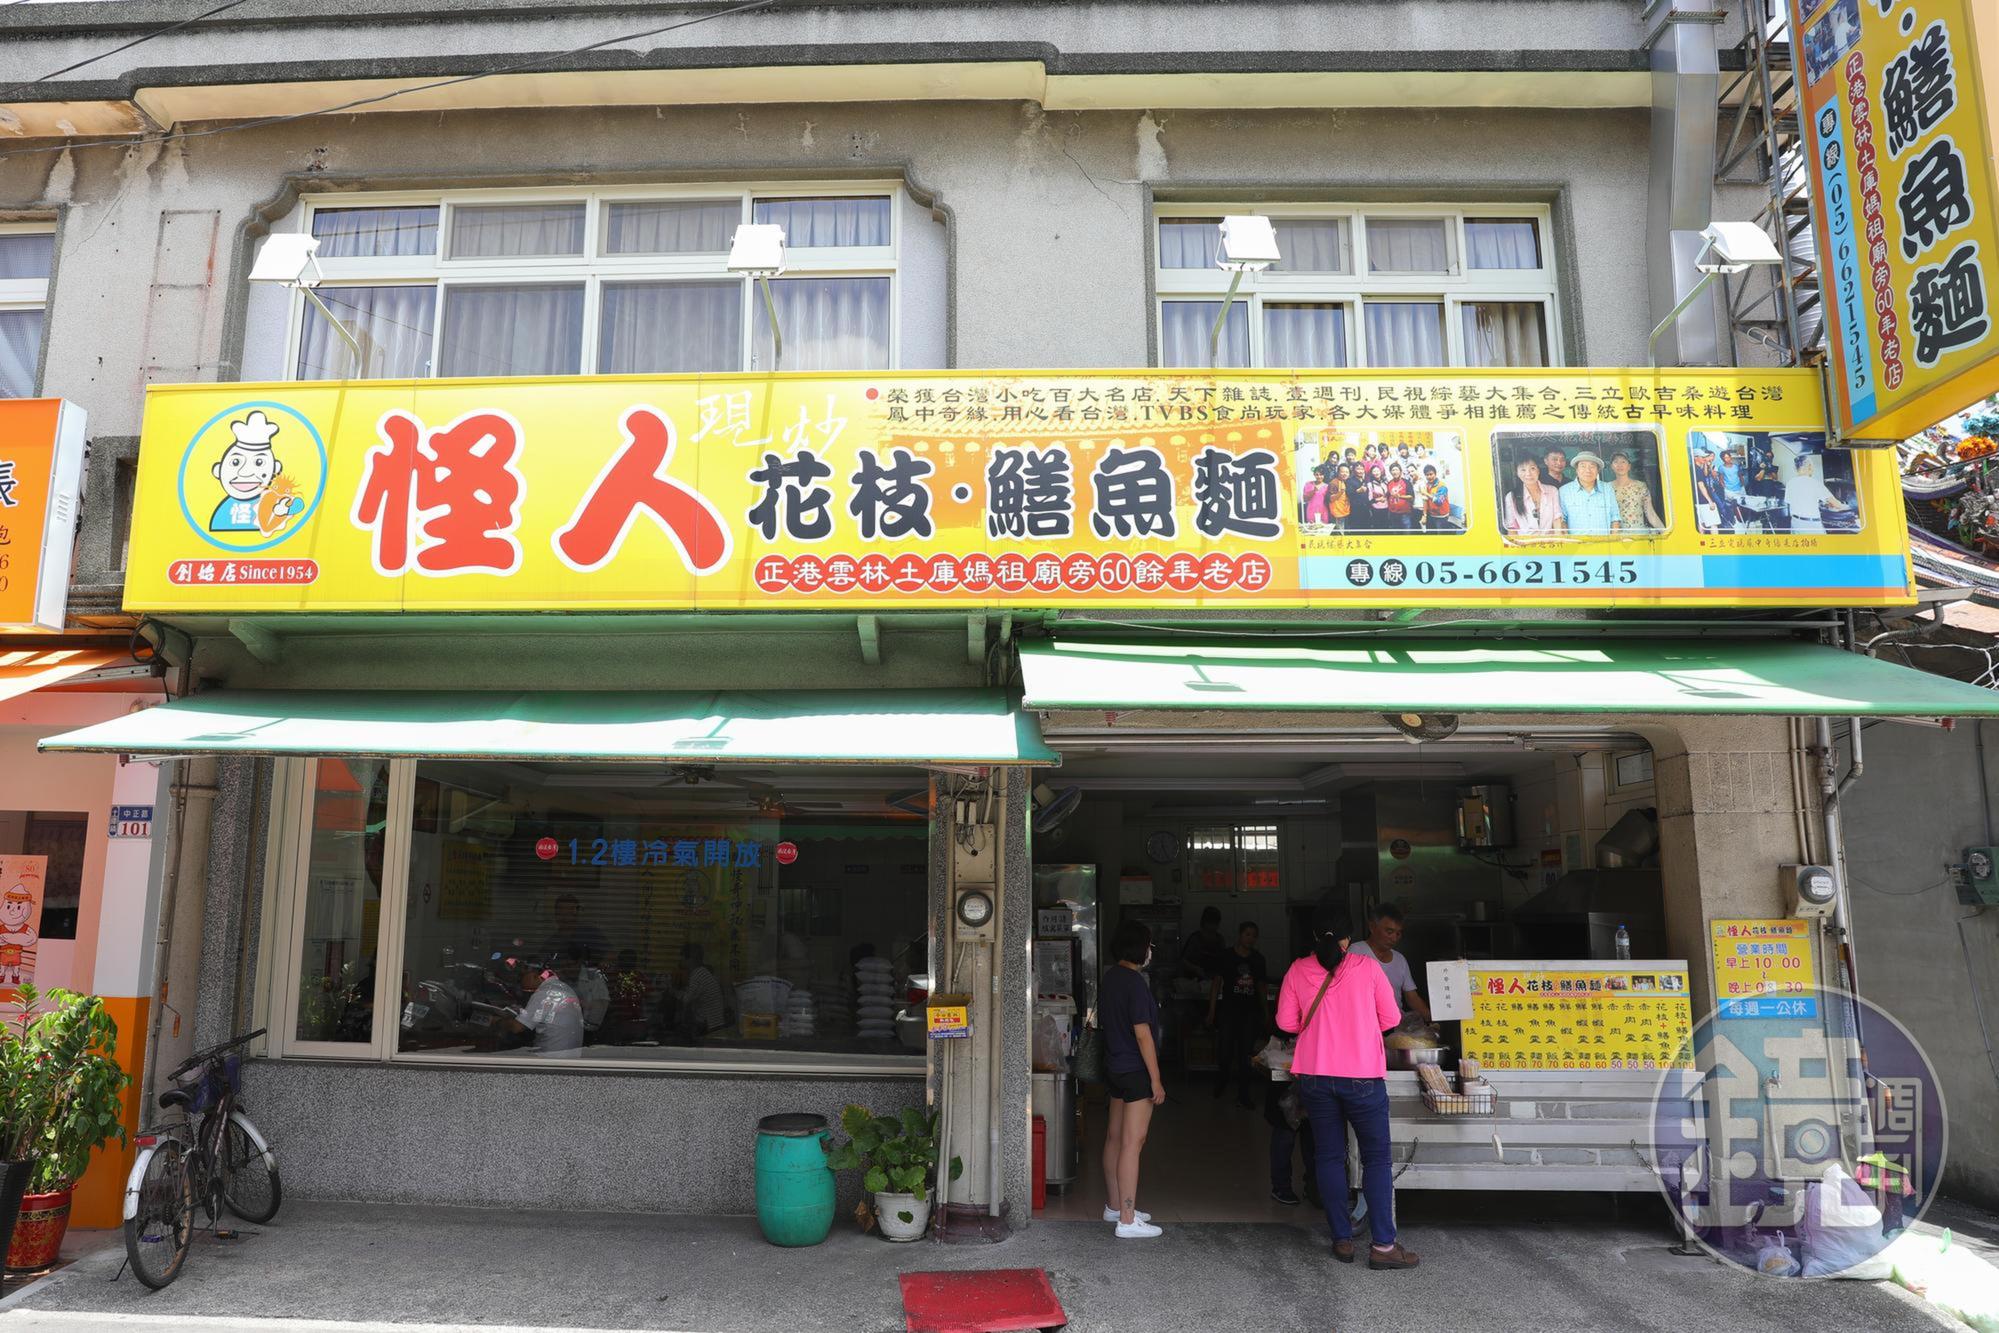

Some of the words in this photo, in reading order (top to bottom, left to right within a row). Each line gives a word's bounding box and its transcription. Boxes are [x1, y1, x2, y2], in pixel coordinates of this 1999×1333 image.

[351, 405, 728, 577] 怪人
[230, 502, 251, 524] 怪
[759, 557, 1268, 588] 正港雲林土庫媽祖廟旁60餘年老店
[1349, 562, 1405, 584] 專線
[1415, 560, 1639, 585] 05-6621545
[121, 822, 147, 836] 101
[1727, 925, 1752, 937] 怪人
[1736, 943, 1788, 955] 營業時間
[1487, 977, 1526, 995] 怪人
[1729, 1001, 1808, 1016] 每週一公休
[1483, 1061, 1495, 1069] 60
[1499, 1061, 1511, 1069] 60
[1516, 1061, 1527, 1069] 70
[1532, 1061, 1543, 1069] 70
[1548, 1061, 1559, 1069] 70
[1563, 1061, 1575, 1069] 60
[1579, 1061, 1590, 1069] 60
[1595, 1061, 1607, 1069] 60
[1611, 1061, 1622, 1069] 50
[1627, 1061, 1638, 1069] 50
[1643, 1061, 1655, 1069] 50
